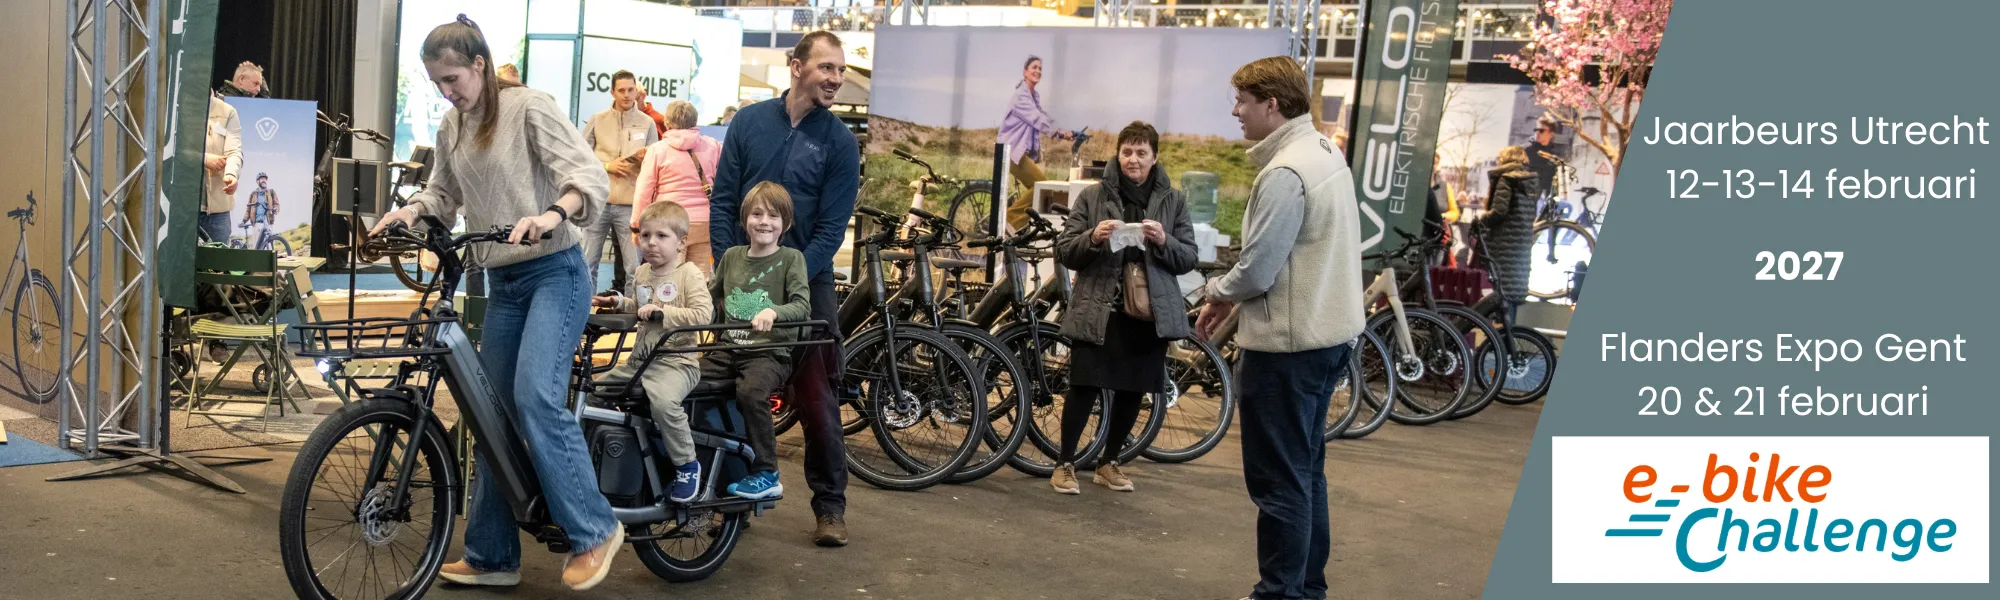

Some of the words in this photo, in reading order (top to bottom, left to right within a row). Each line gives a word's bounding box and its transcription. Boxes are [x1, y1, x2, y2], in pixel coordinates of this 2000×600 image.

[586, 72, 677, 98] SCALBE
[1360, 6, 1415, 252] VELO
[1389, 67, 1429, 214] ELEKTRISCHE
